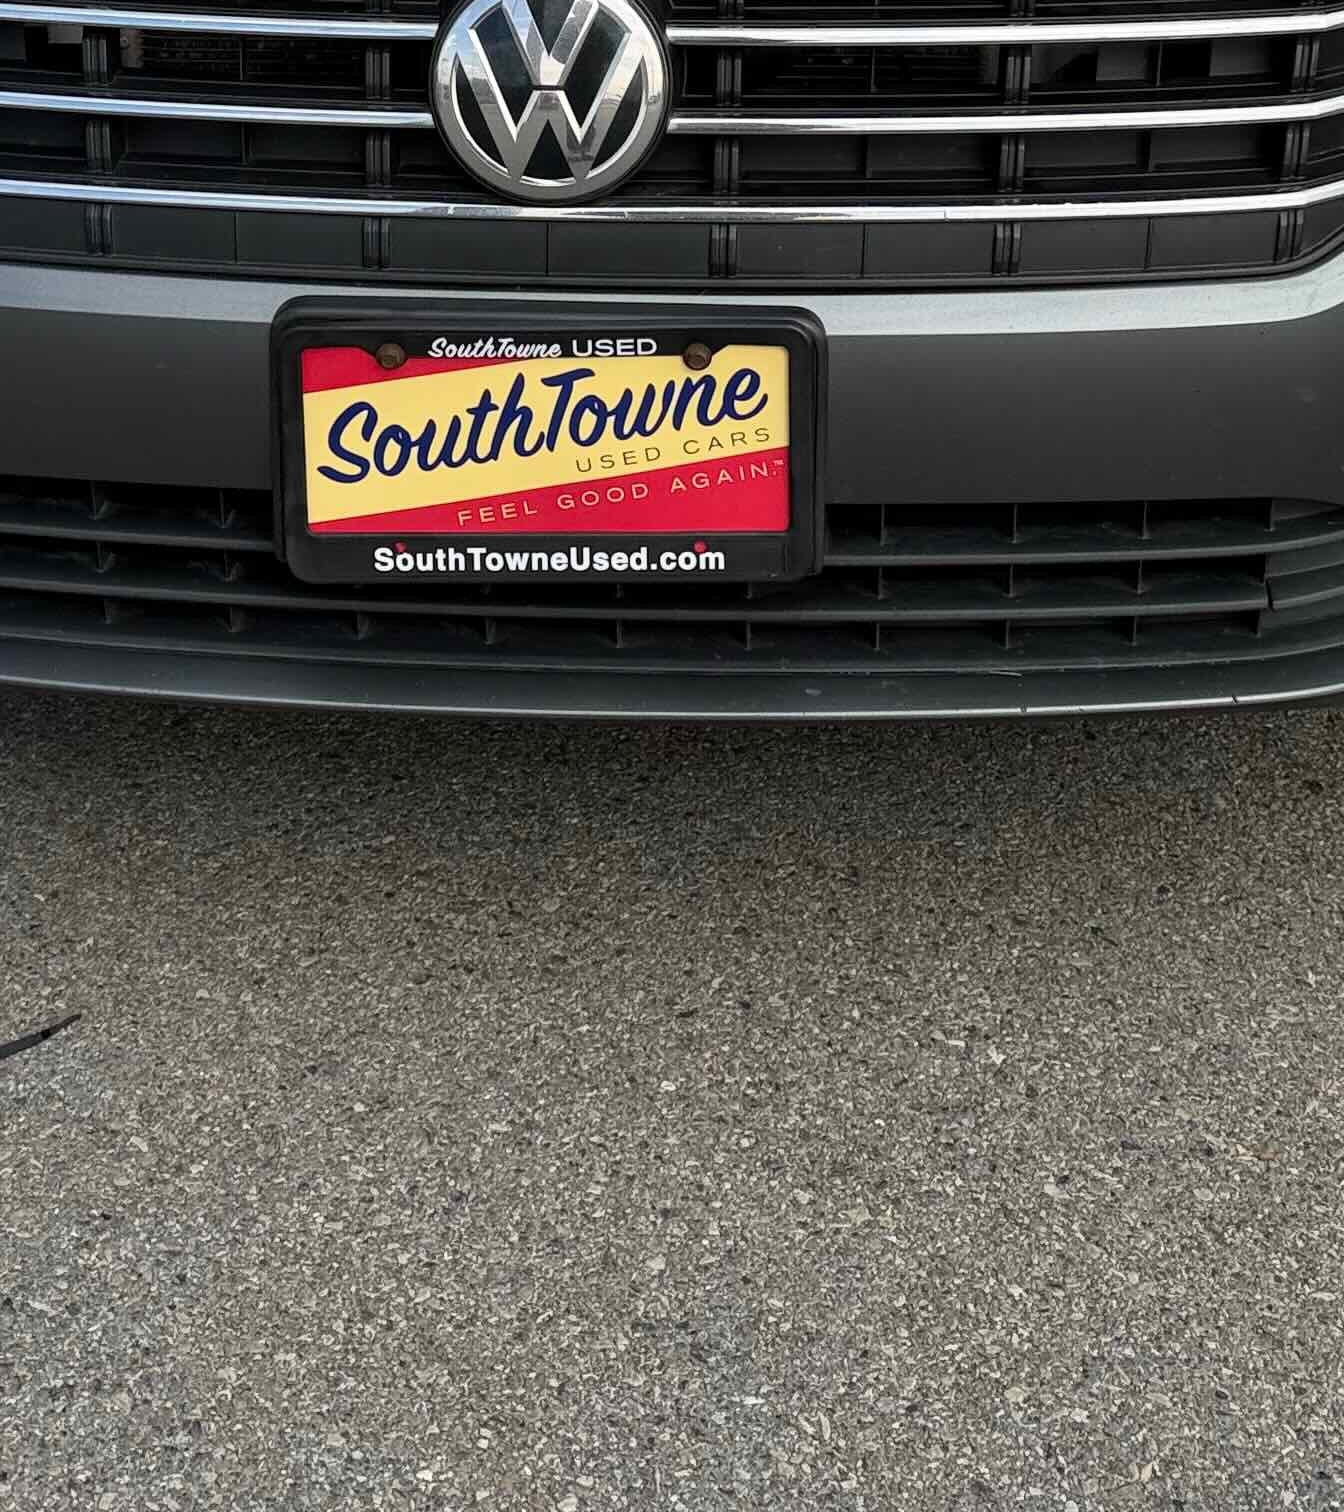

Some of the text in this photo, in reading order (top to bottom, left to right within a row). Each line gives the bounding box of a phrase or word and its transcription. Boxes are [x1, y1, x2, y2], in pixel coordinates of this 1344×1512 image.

[428, 336, 657, 358] SouthTowne USED
[317, 367, 769, 484] SouthTowne
[575, 427, 770, 473] USED CARS
[457, 500, 539, 527] FEEL
[557, 482, 649, 510] GOOD
[373, 546, 725, 573] SouthTowneUsed.com
